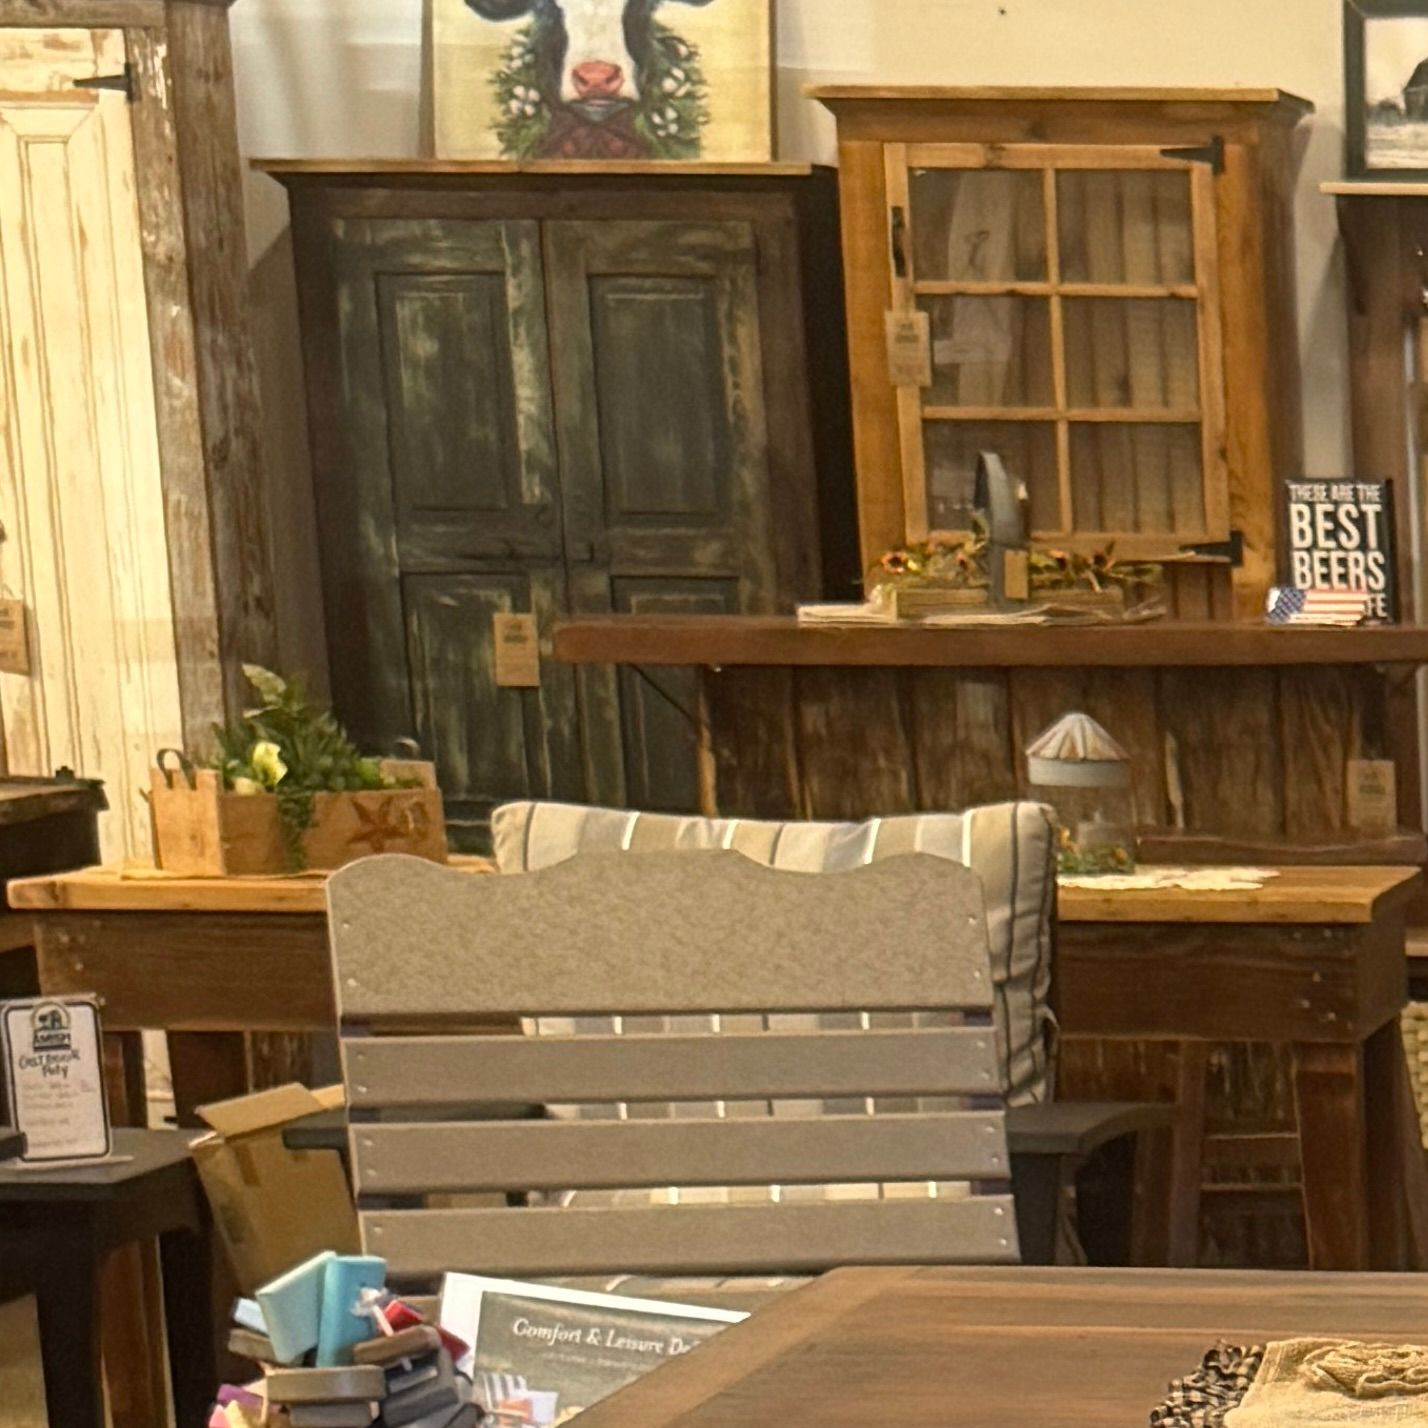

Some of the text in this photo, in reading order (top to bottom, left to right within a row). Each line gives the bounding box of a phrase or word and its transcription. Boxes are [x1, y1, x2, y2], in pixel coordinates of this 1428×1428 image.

[1288, 483, 1381, 502] THESE ARE THE
[1290, 503, 1382, 549] BEST
[1292, 550, 1386, 591] BEERS
[512, 1317, 581, 1346] Comfort
[585, 1330, 600, 1346] &
[605, 1330, 664, 1355] Leisure
